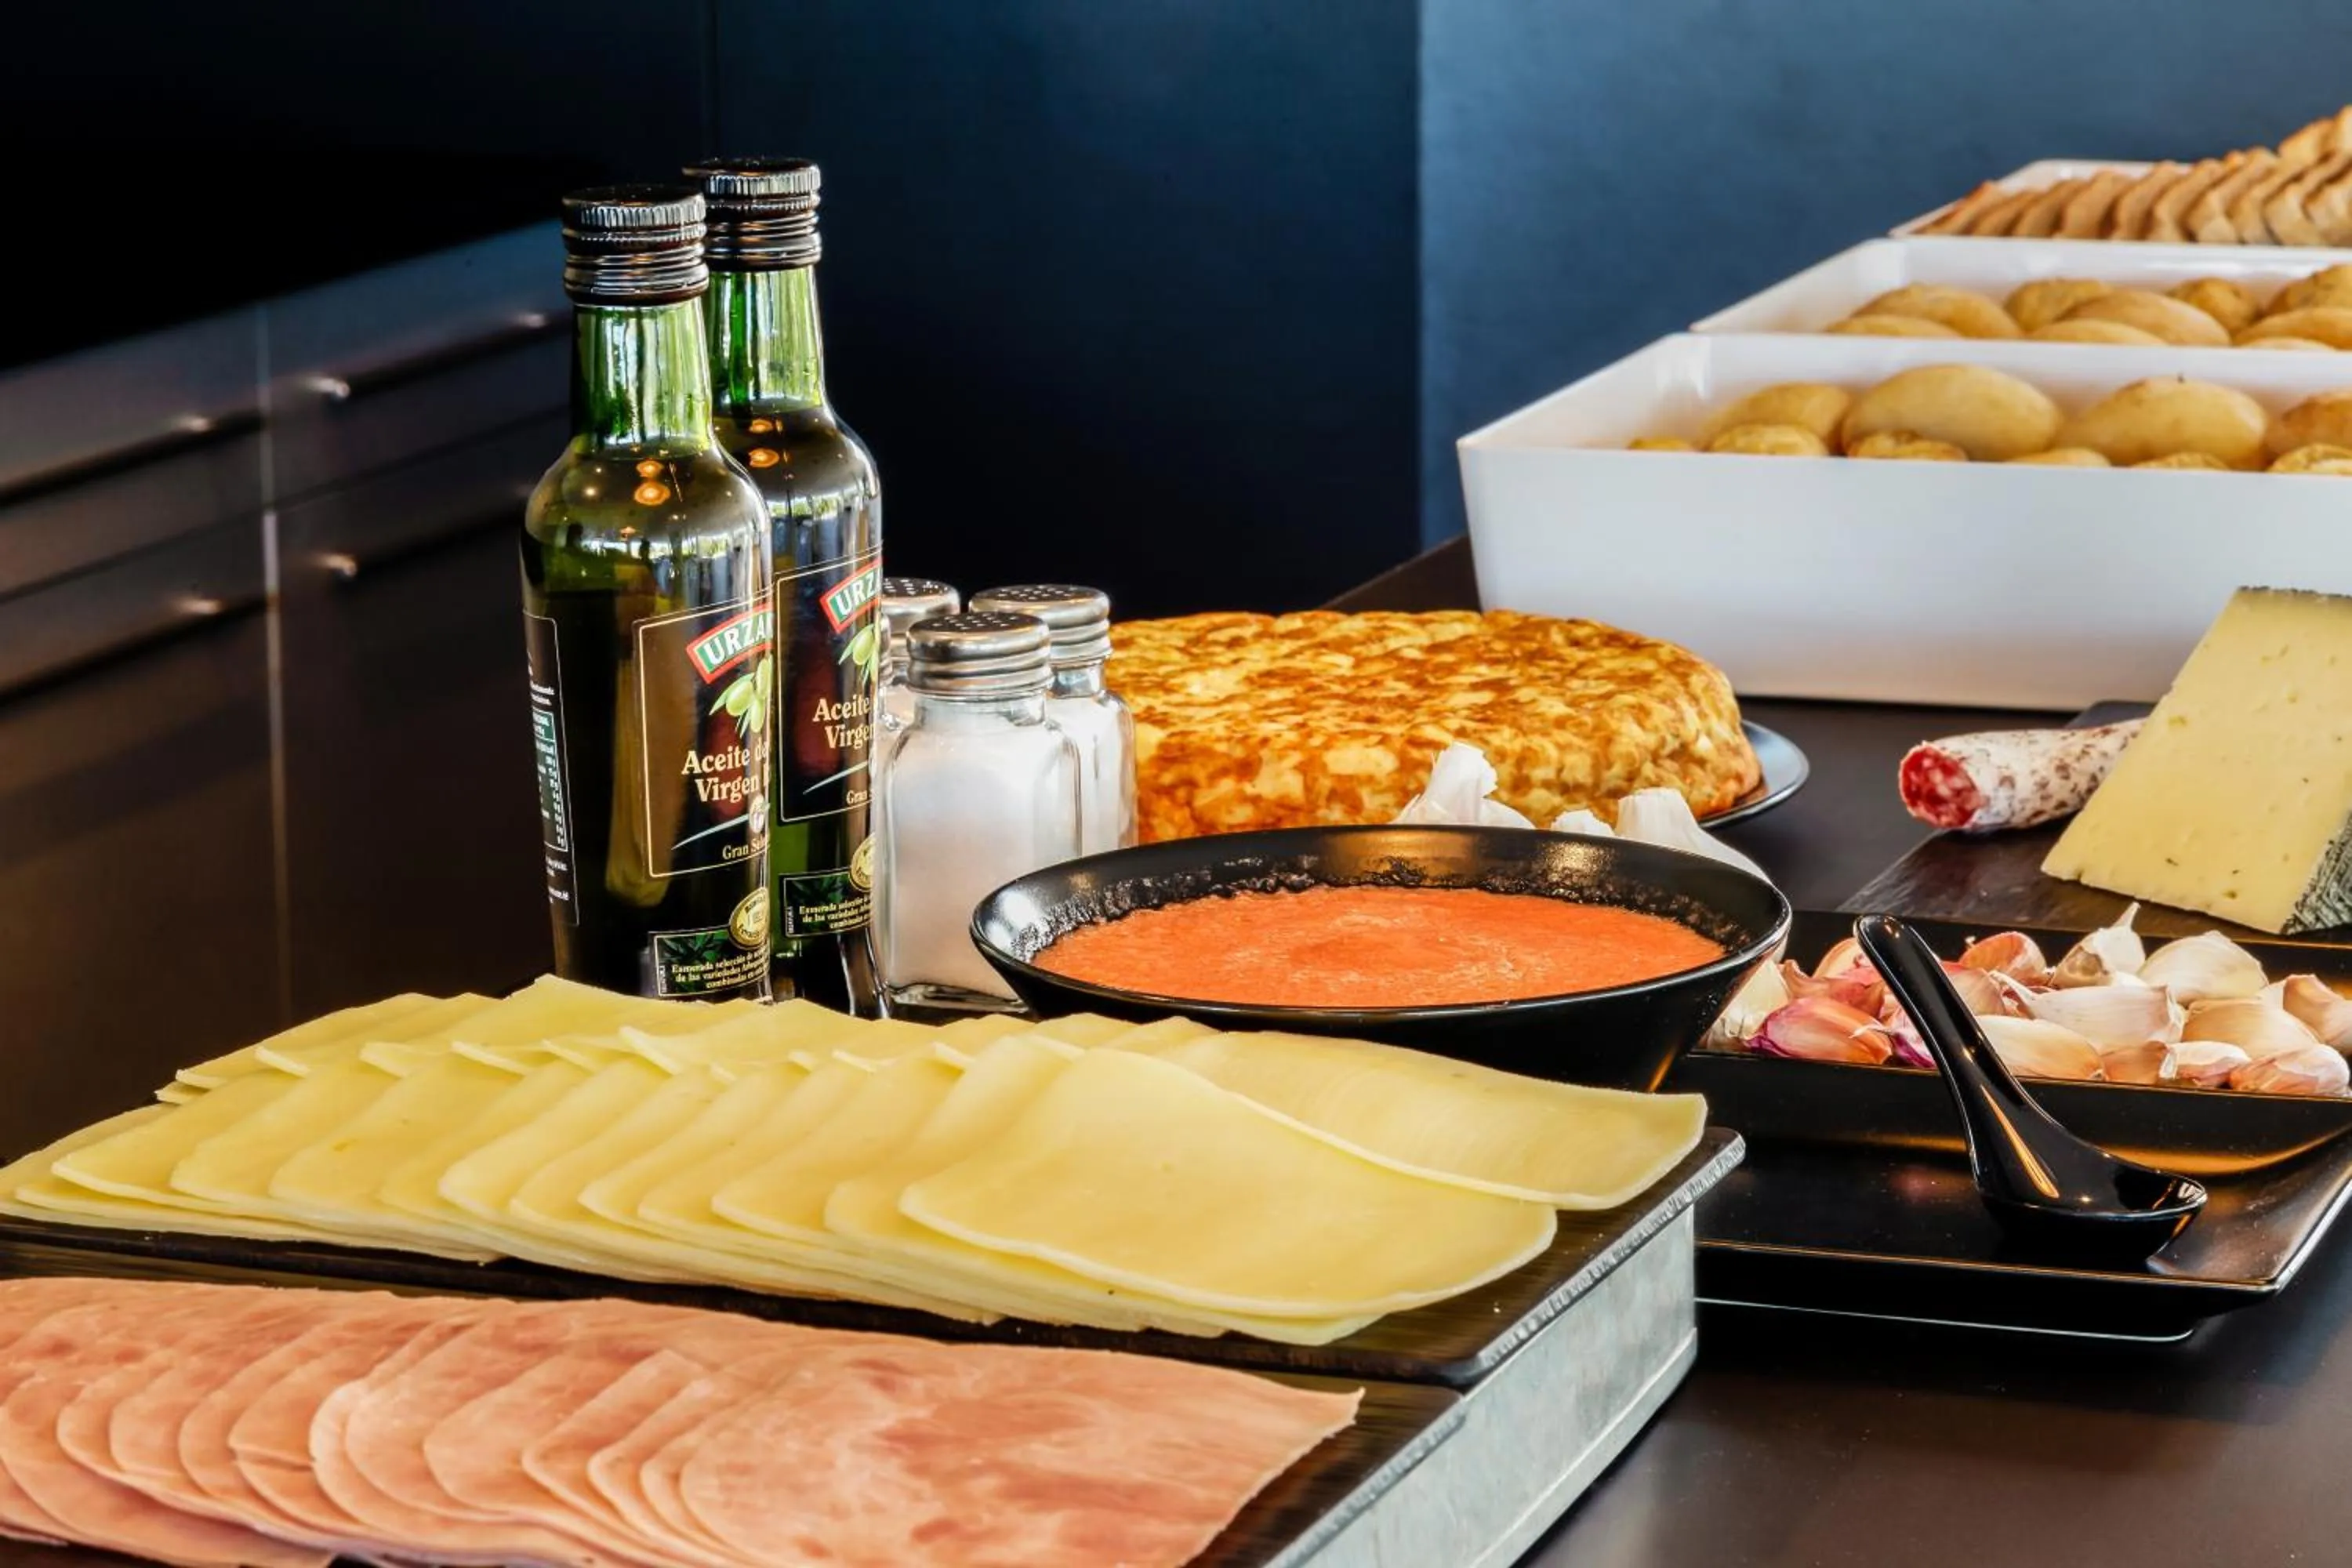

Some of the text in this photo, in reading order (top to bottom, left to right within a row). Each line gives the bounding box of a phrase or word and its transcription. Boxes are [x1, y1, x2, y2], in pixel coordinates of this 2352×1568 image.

[812, 694, 869, 723] Aceite
[681, 746, 750, 775] Aceite
[695, 775, 759, 803] Virgen
[846, 789, 868, 804] Gran
[722, 843, 750, 860] Gran
